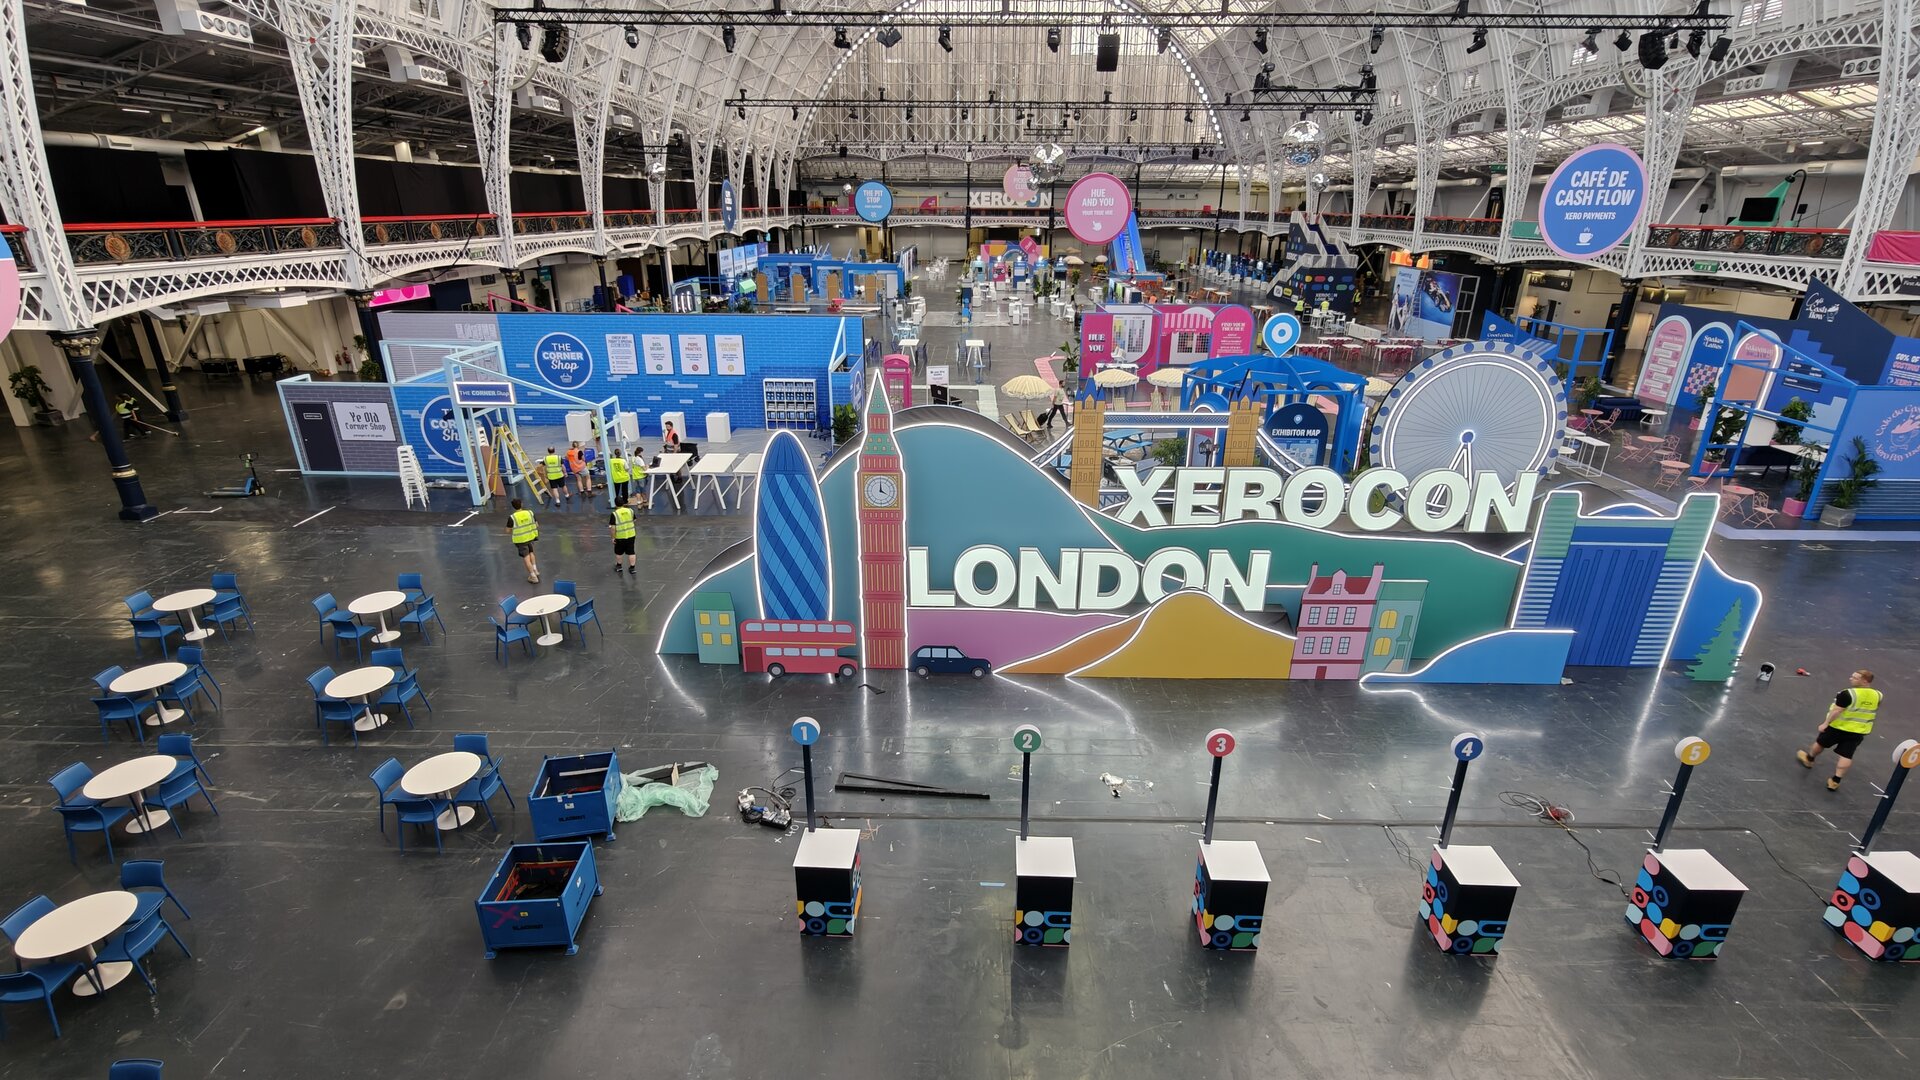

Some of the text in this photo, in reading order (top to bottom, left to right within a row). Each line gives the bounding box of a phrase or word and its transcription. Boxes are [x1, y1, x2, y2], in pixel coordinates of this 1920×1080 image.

[1571, 167, 1629, 188] CAFÉ DE
[863, 189, 883, 197] THE PIT
[866, 196, 881, 204] STOP
[969, 191, 1053, 209] XEROON
[1091, 188, 1106, 198] HUE
[1555, 189, 1635, 206] CASH FLOW
[1082, 198, 1114, 207] AND YOU
[1564, 212, 1617, 220] XERO PAYMENTS
[551, 342, 572, 351] THE
[542, 351, 584, 361] CORNER
[551, 359, 579, 373] Shop
[349, 411, 380, 423] Ye Old
[345, 422, 387, 432] Corner Shop
[1271, 428, 1321, 437] EXHIBITOR MAP
[1113, 466, 1539, 533] XEROCON
[908, 544, 1272, 612] LONDON
[800, 725, 808, 741] 1
[1022, 733, 1033, 749] 2
[1215, 737, 1227, 753] 3
[1461, 741, 1473, 757] 4
[1689, 745, 1702, 761] 5
[1908, 748, 1919, 764] 6
